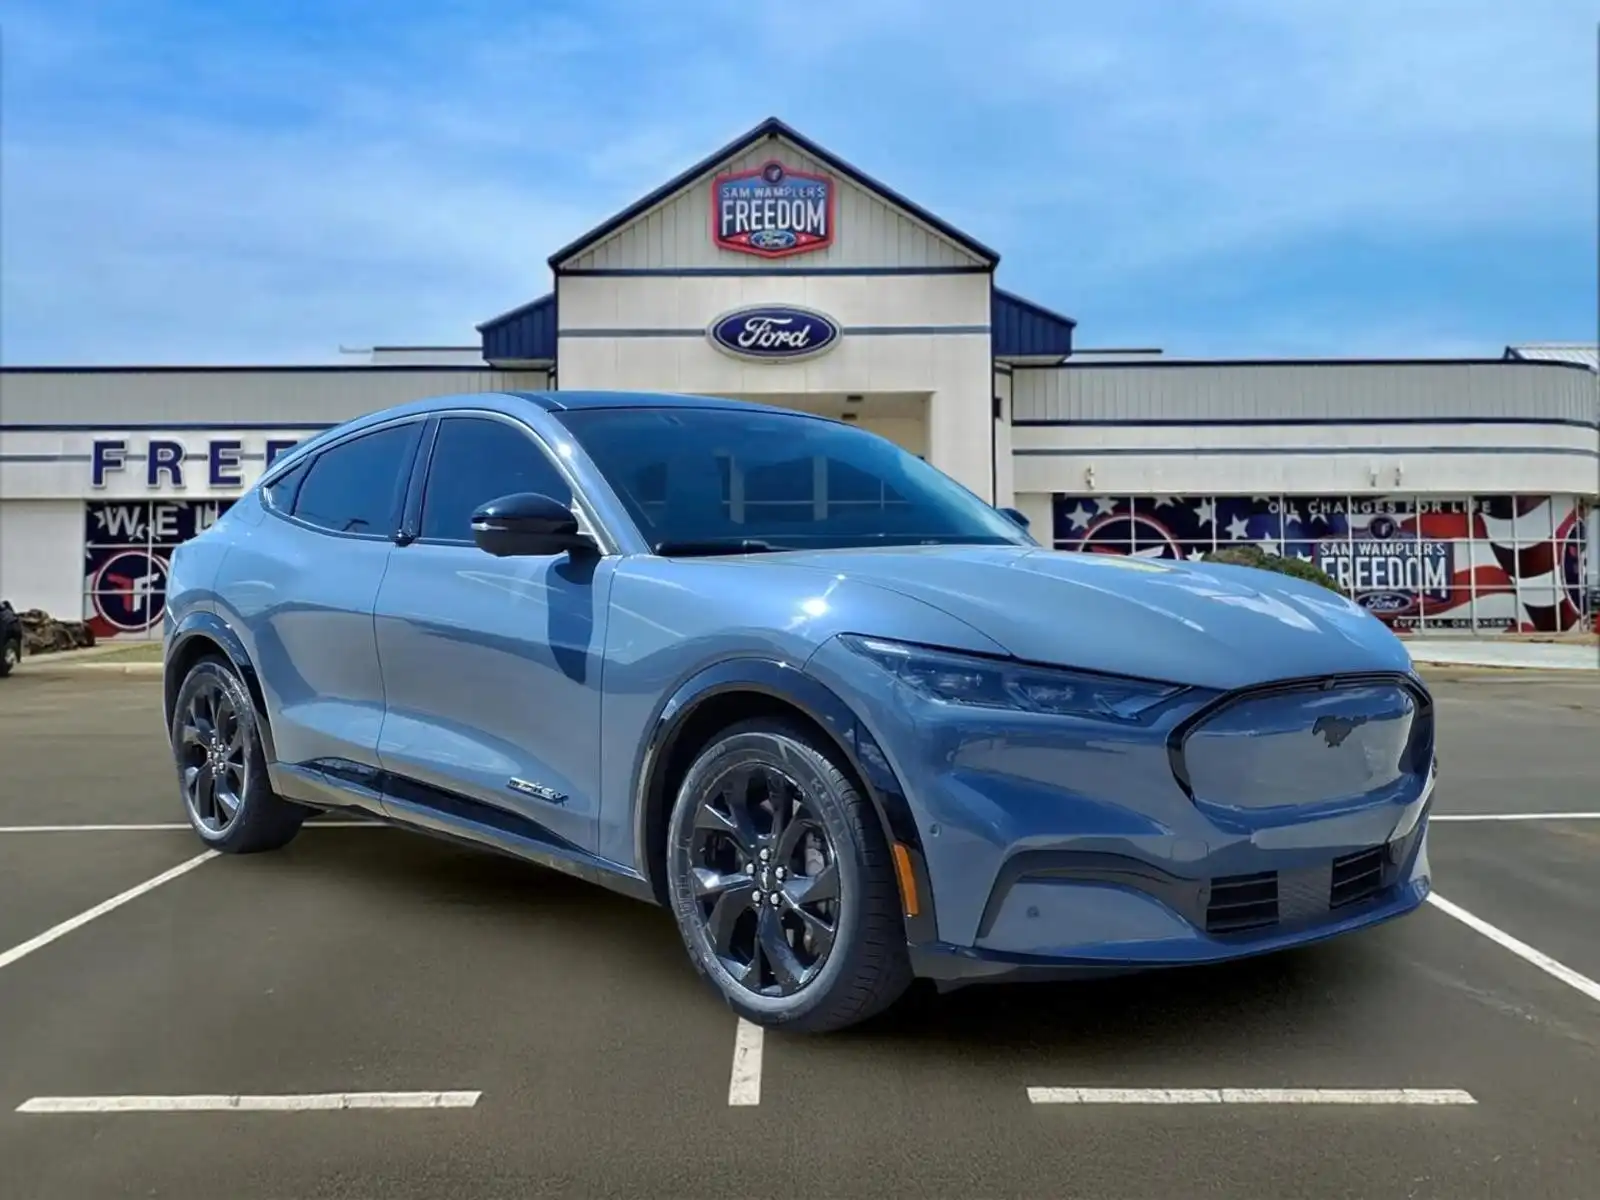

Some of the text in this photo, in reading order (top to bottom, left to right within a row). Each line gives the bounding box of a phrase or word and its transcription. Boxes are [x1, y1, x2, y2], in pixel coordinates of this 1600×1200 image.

[722, 185, 826, 198] SAM WAMPLER'S
[721, 199, 826, 236] FREEDOM
[738, 316, 812, 347] Ford
[1267, 501, 1300, 514] OIL
[1308, 500, 1397, 514] CHANGES
[1405, 501, 1442, 514] FOR
[1321, 556, 1448, 598] FREEDOM
[1366, 594, 1400, 609] Ford
